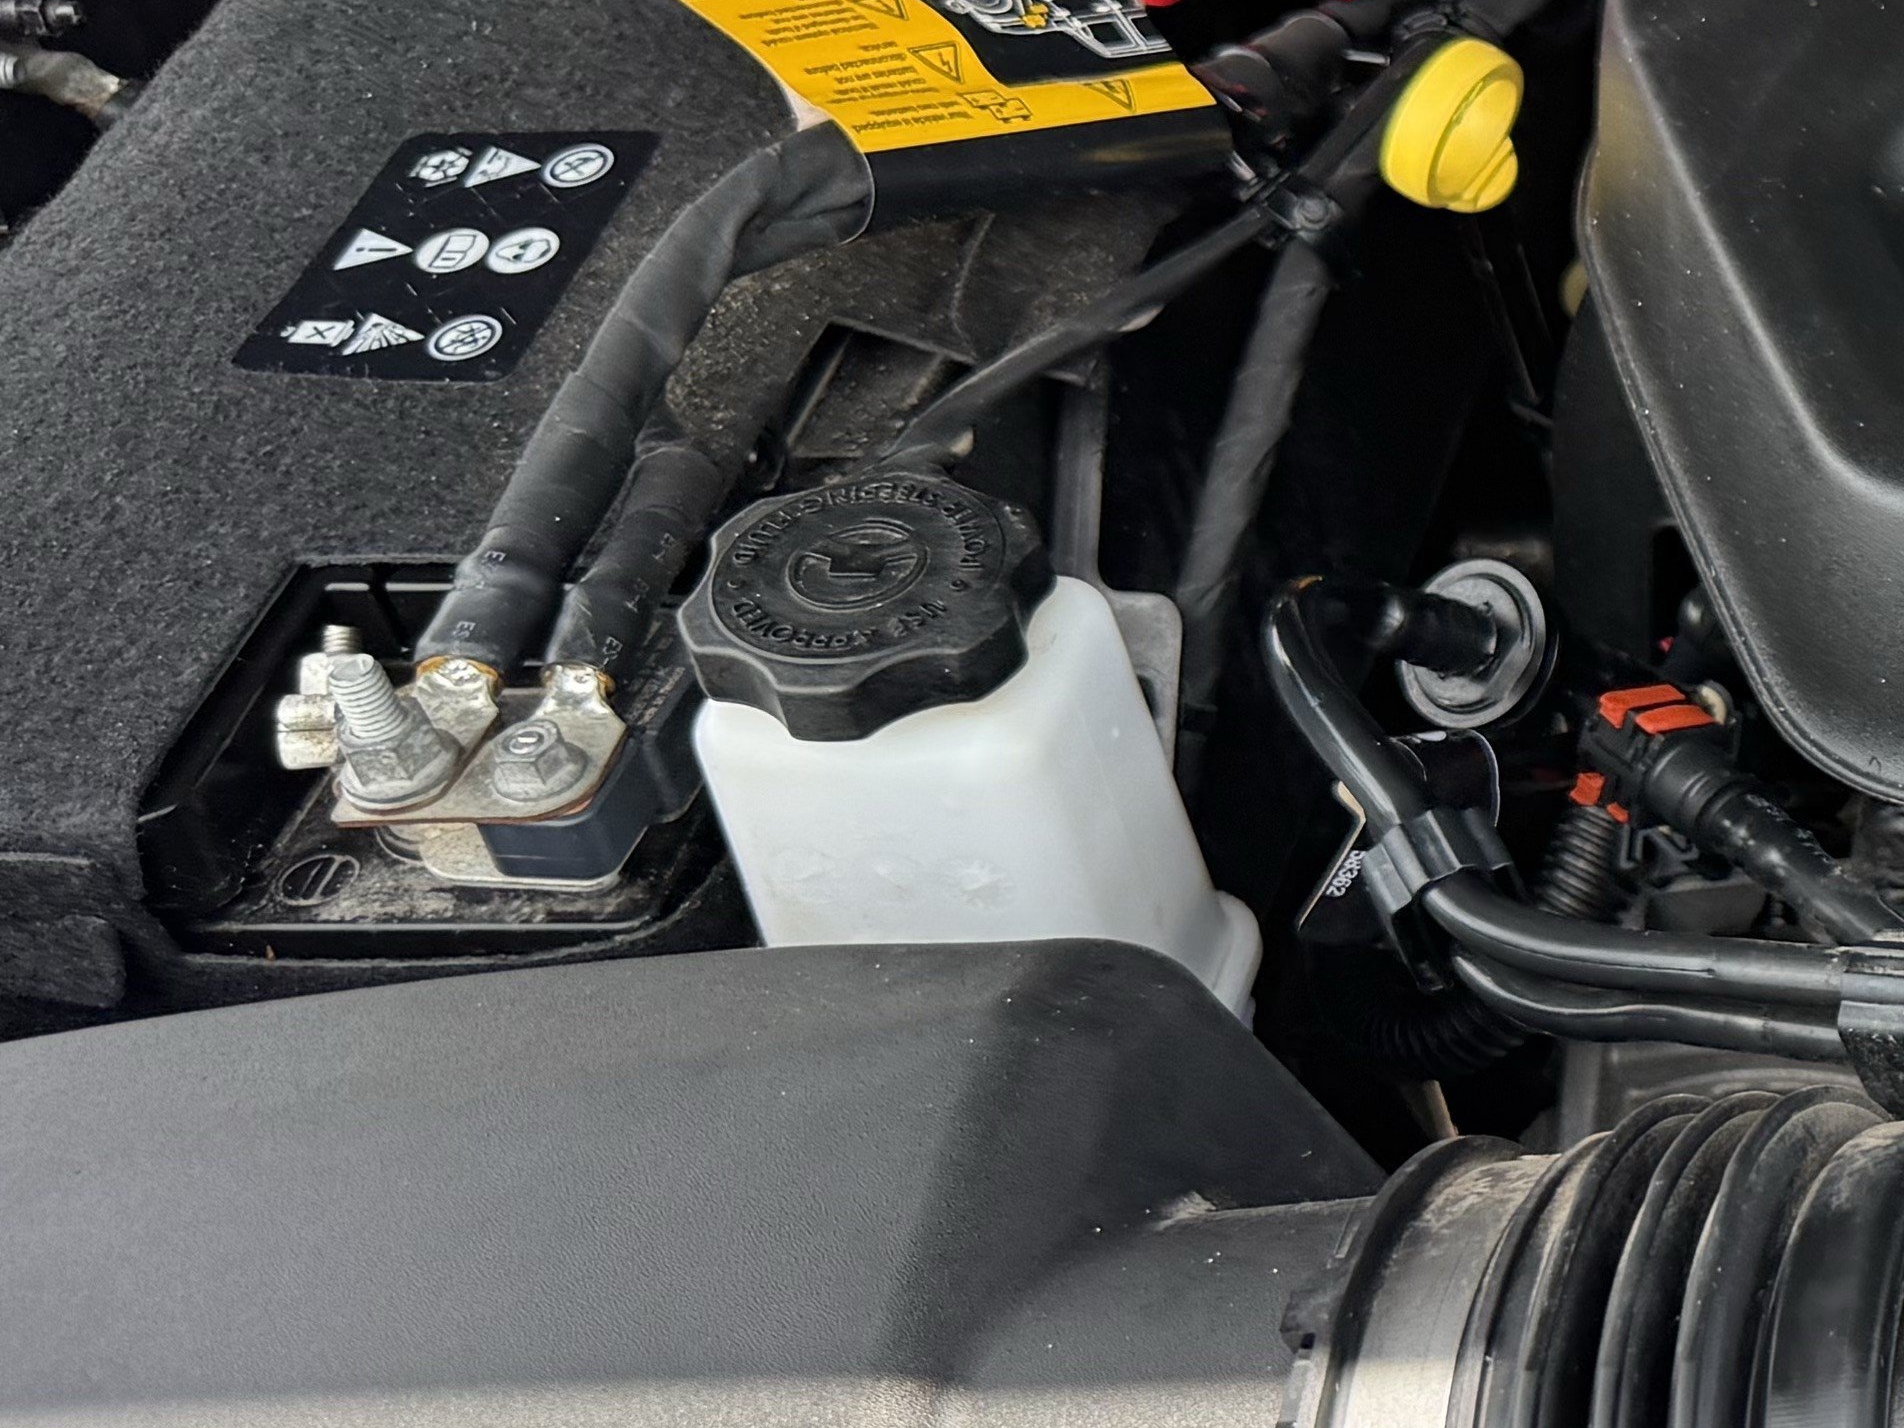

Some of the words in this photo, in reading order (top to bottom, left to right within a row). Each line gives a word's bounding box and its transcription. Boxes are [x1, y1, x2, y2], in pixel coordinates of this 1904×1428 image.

[800, 480, 941, 516] STEERING
[730, 509, 794, 568] FLUID
[939, 502, 988, 572] POWER
[730, 596, 879, 651] APPROVED
[885, 598, 948, 639] USE
